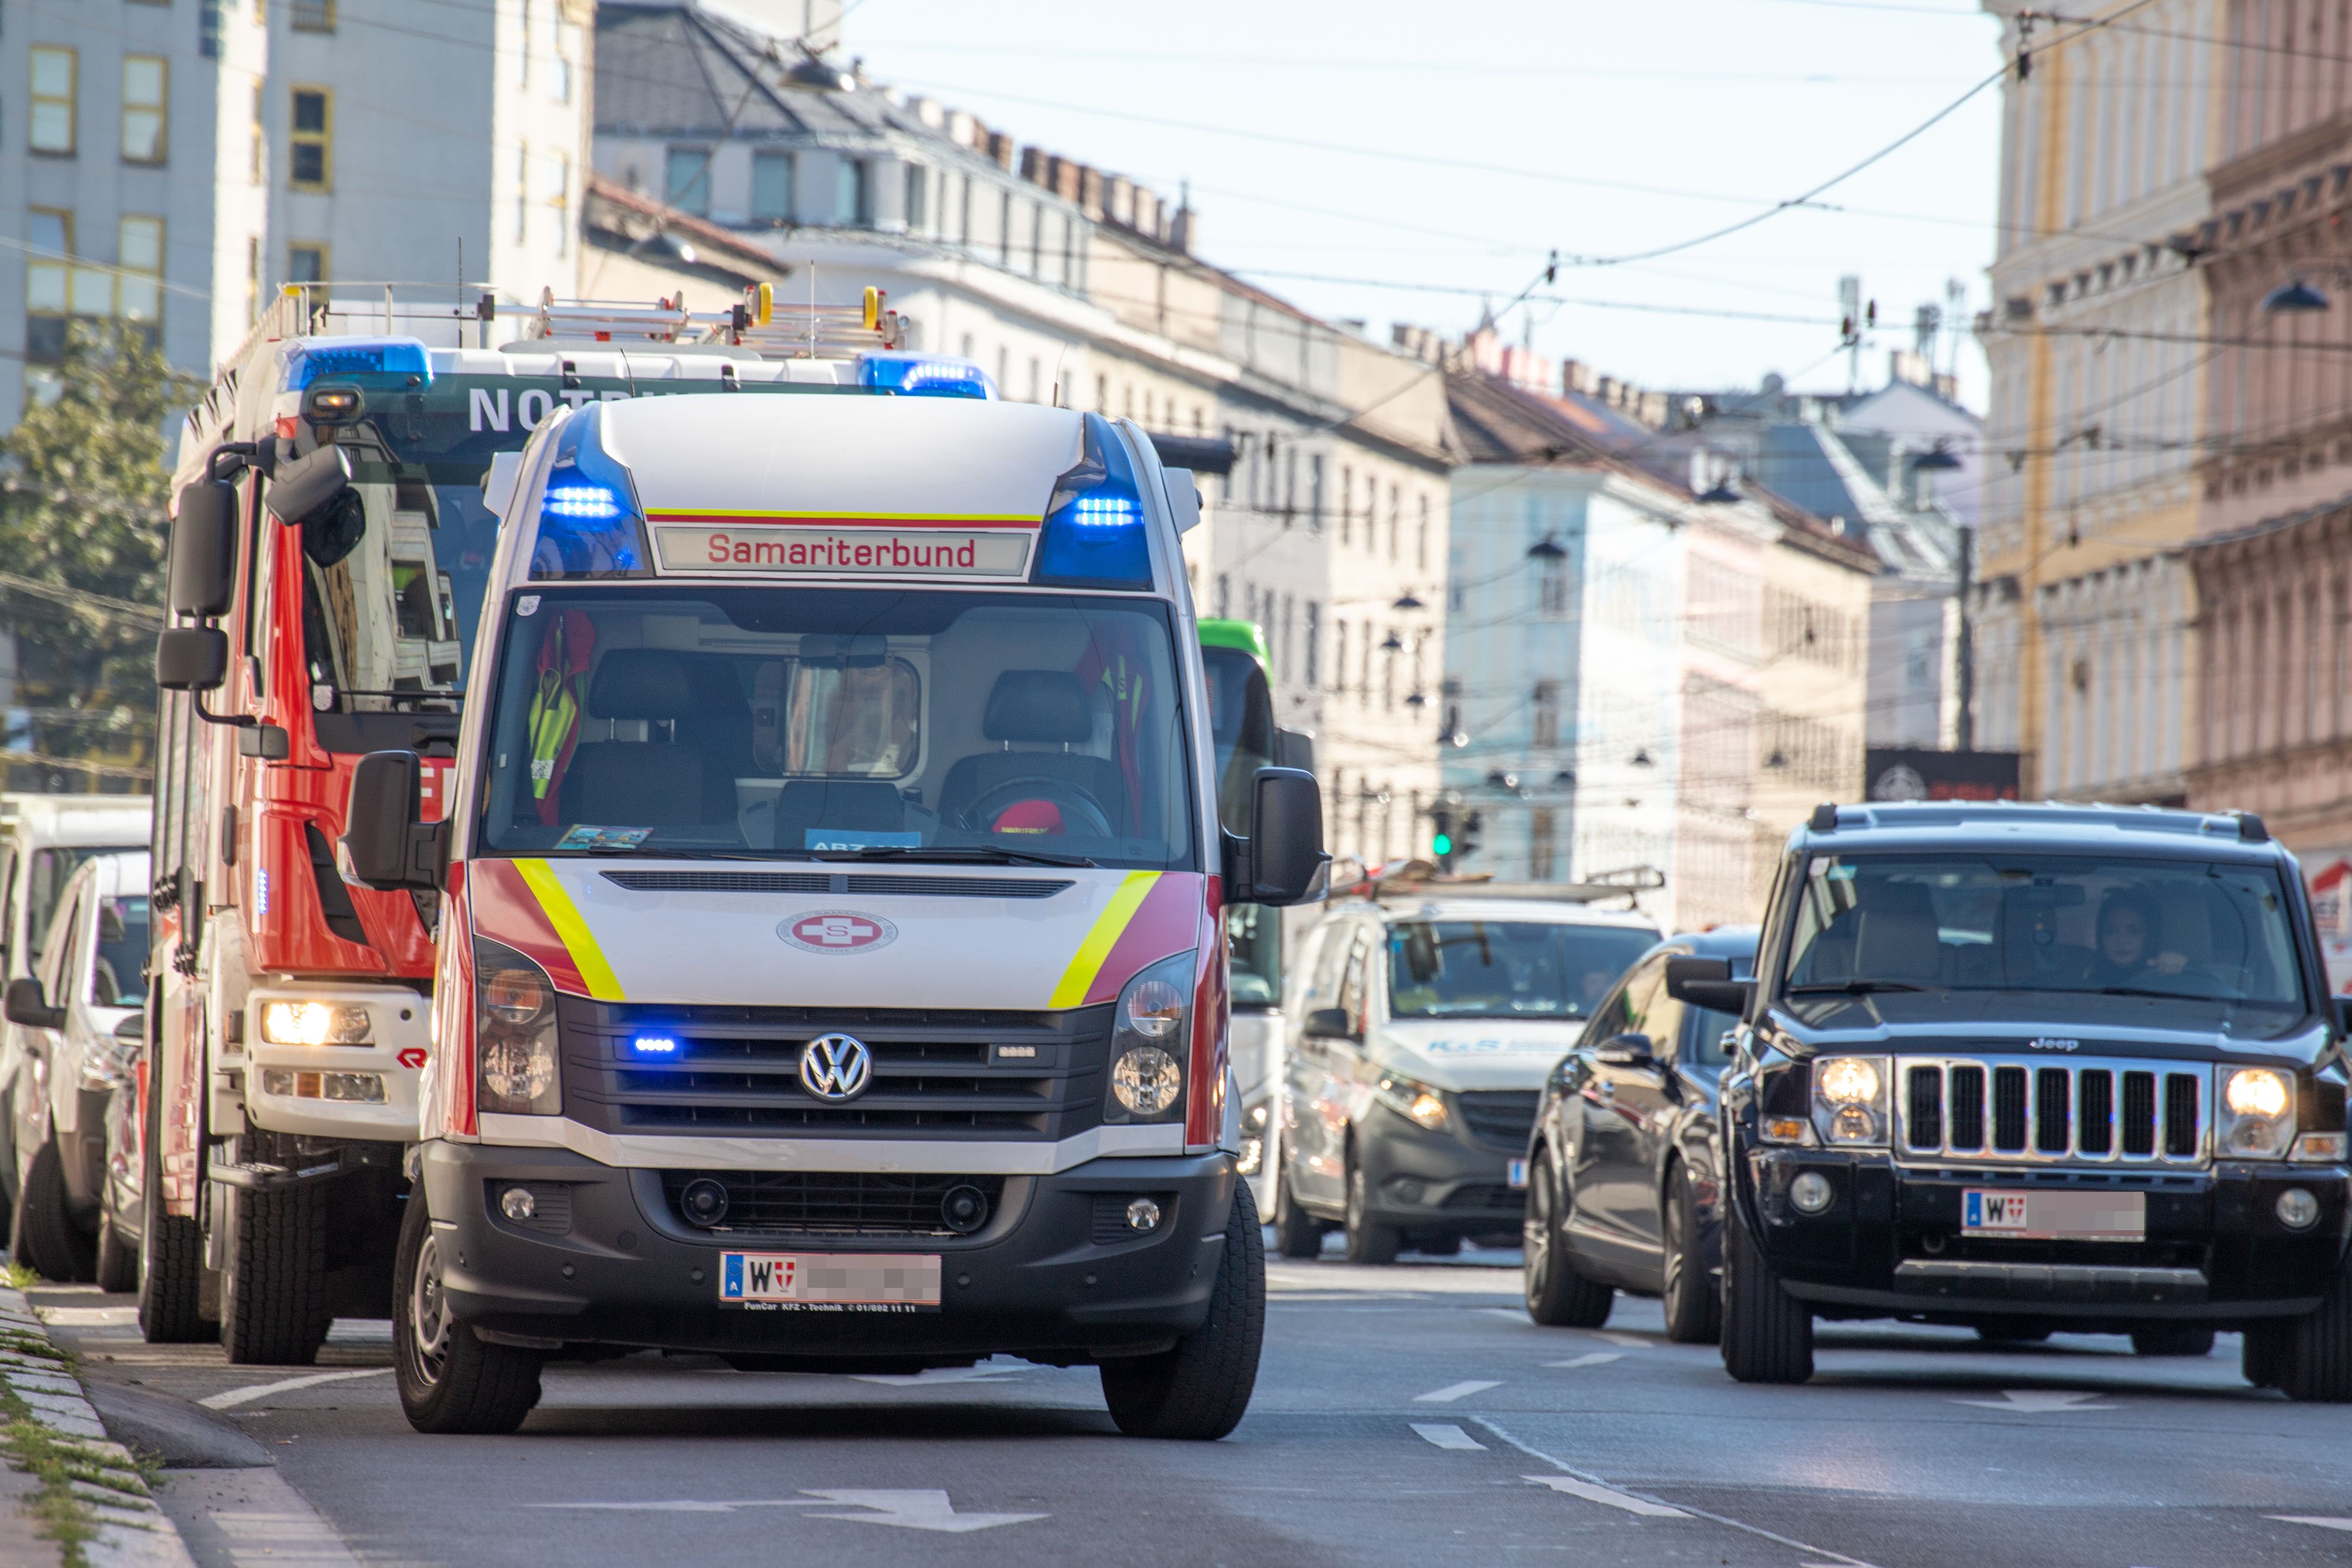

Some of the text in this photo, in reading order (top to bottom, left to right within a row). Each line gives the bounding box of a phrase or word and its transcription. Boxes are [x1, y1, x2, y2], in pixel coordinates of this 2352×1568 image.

[708, 534, 975, 568] Samariterbund
[826, 925, 848, 937] S
[2029, 1038, 2079, 1052] Jeep
[1986, 1197, 2004, 1222] W
[729, 1261, 772, 1293] A W
[744, 1302, 777, 1310] FunCar
[781, 1303, 800, 1311] KFZ
[809, 1303, 843, 1312] Technik
